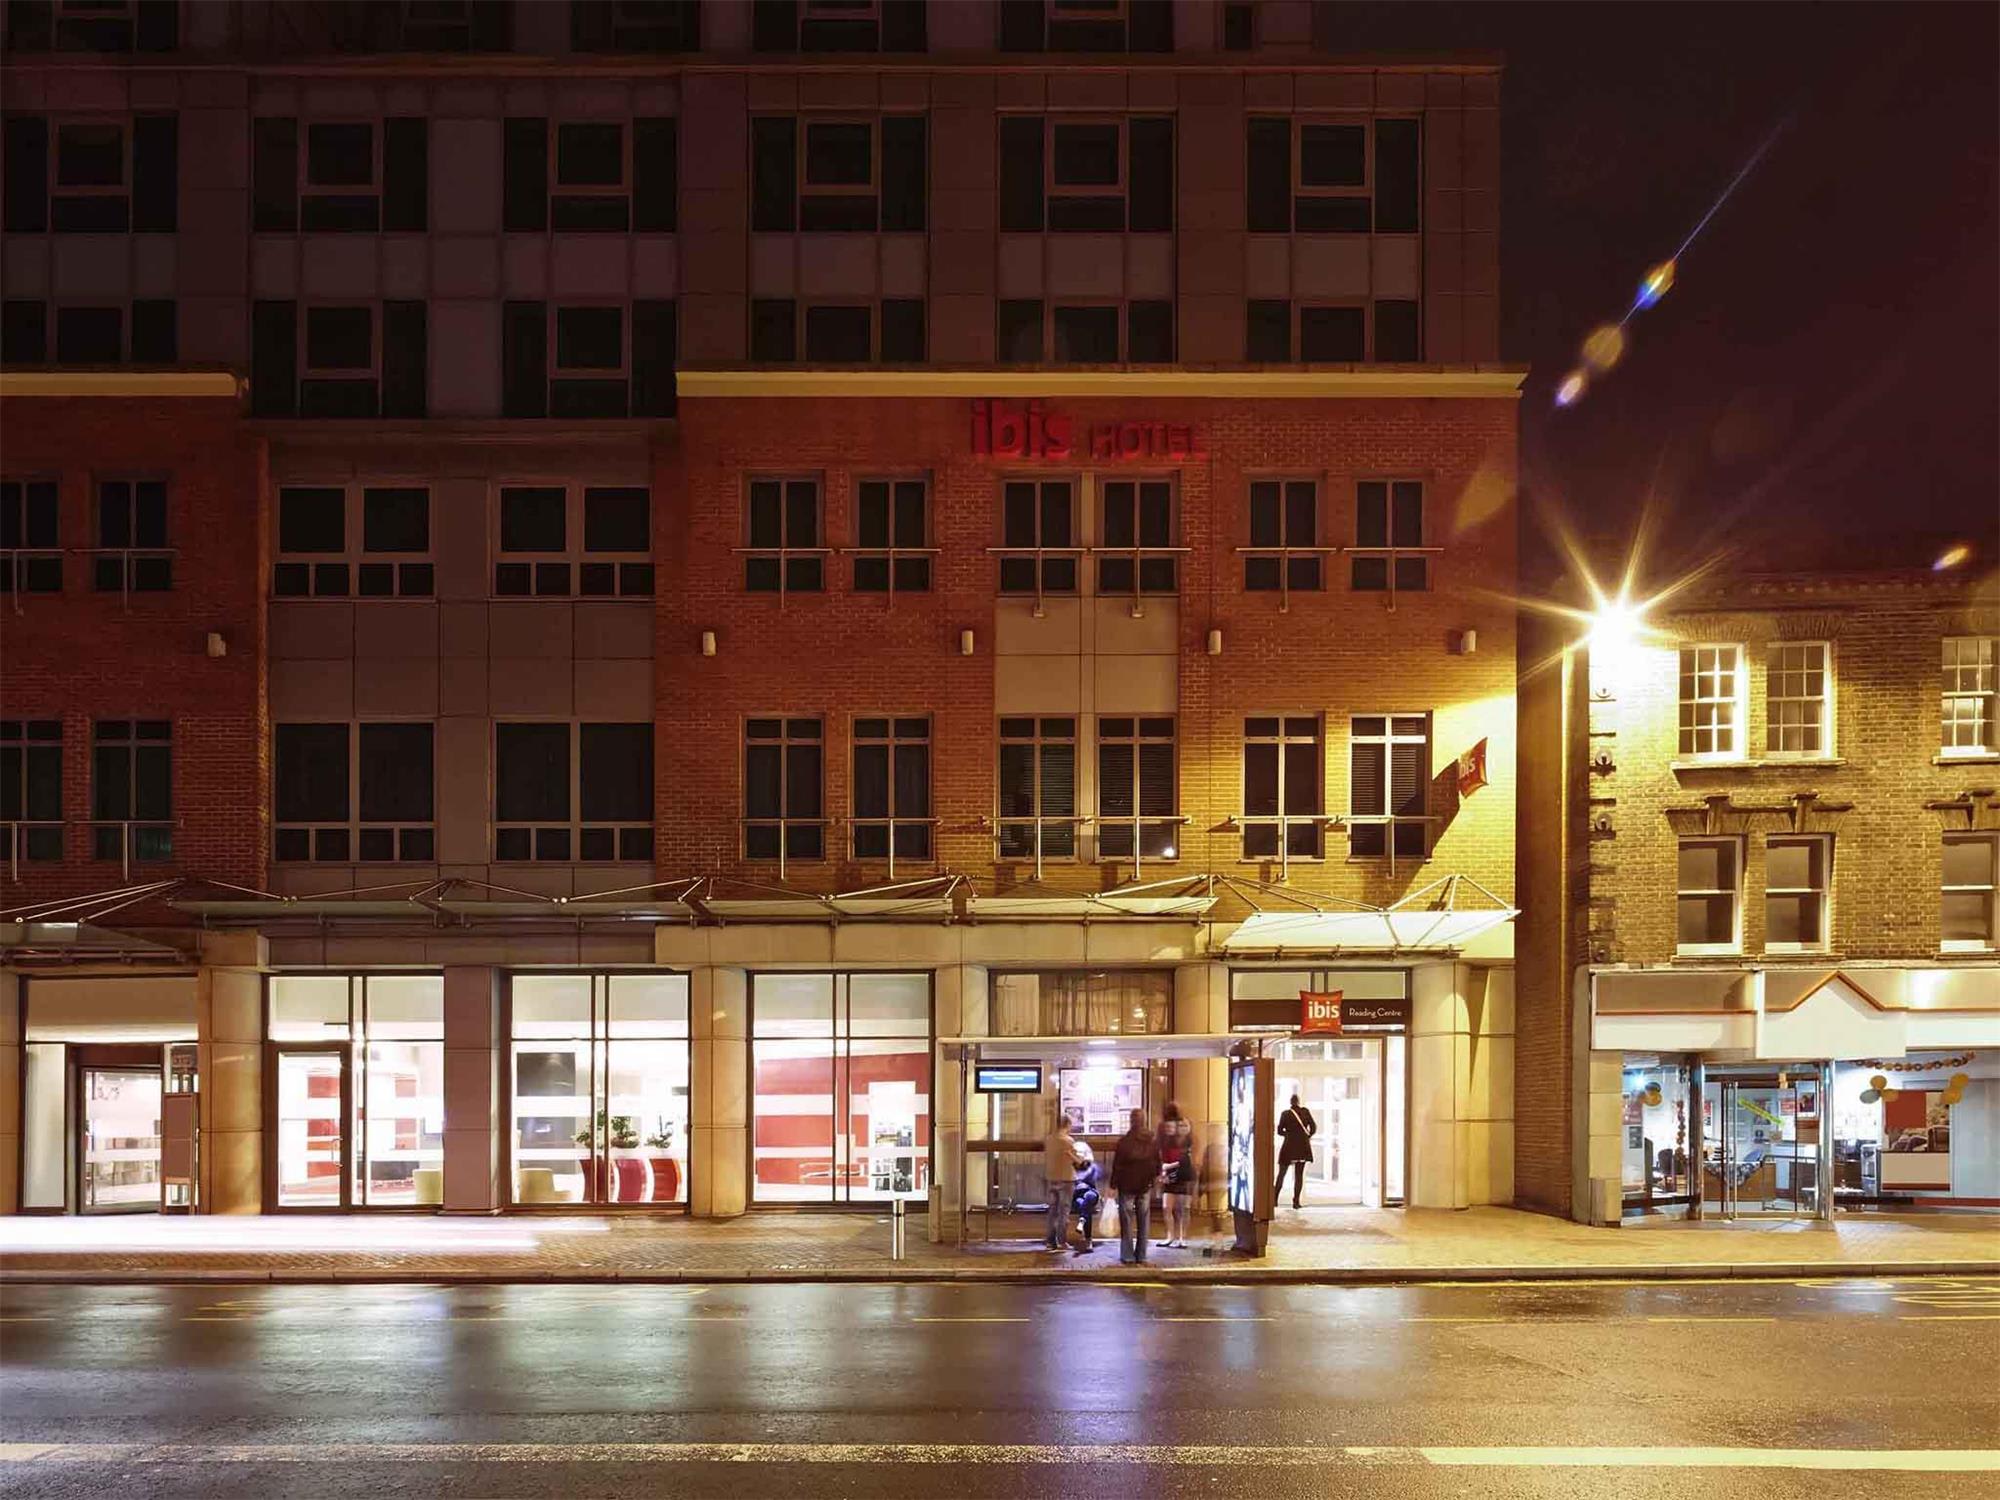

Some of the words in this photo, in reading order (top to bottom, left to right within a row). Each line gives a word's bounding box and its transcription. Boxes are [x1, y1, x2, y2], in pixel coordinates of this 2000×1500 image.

[971, 398, 1072, 460] ibis
[1089, 420, 1208, 460] HOTEL
[1308, 1001, 1340, 1019] ibis
[1349, 1008, 1376, 1019] Reading
[1377, 1008, 1402, 1017] Centre
